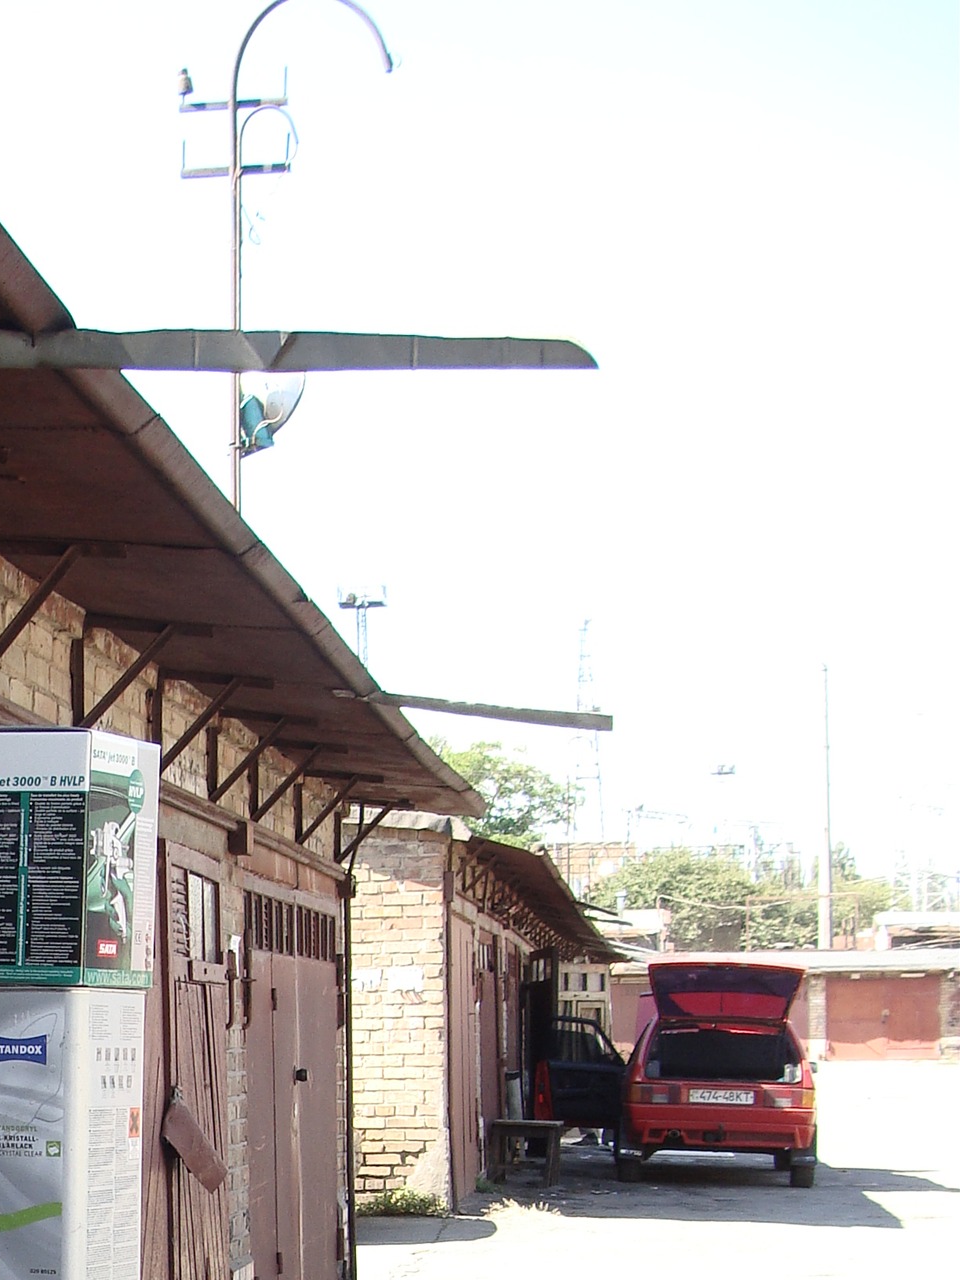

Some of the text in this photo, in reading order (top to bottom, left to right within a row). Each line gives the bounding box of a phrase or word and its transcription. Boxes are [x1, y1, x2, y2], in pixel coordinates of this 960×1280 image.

[49, 776, 57, 786] B
[59, 775, 85, 786] HVLP
[98, 942, 118, 955] SATA
